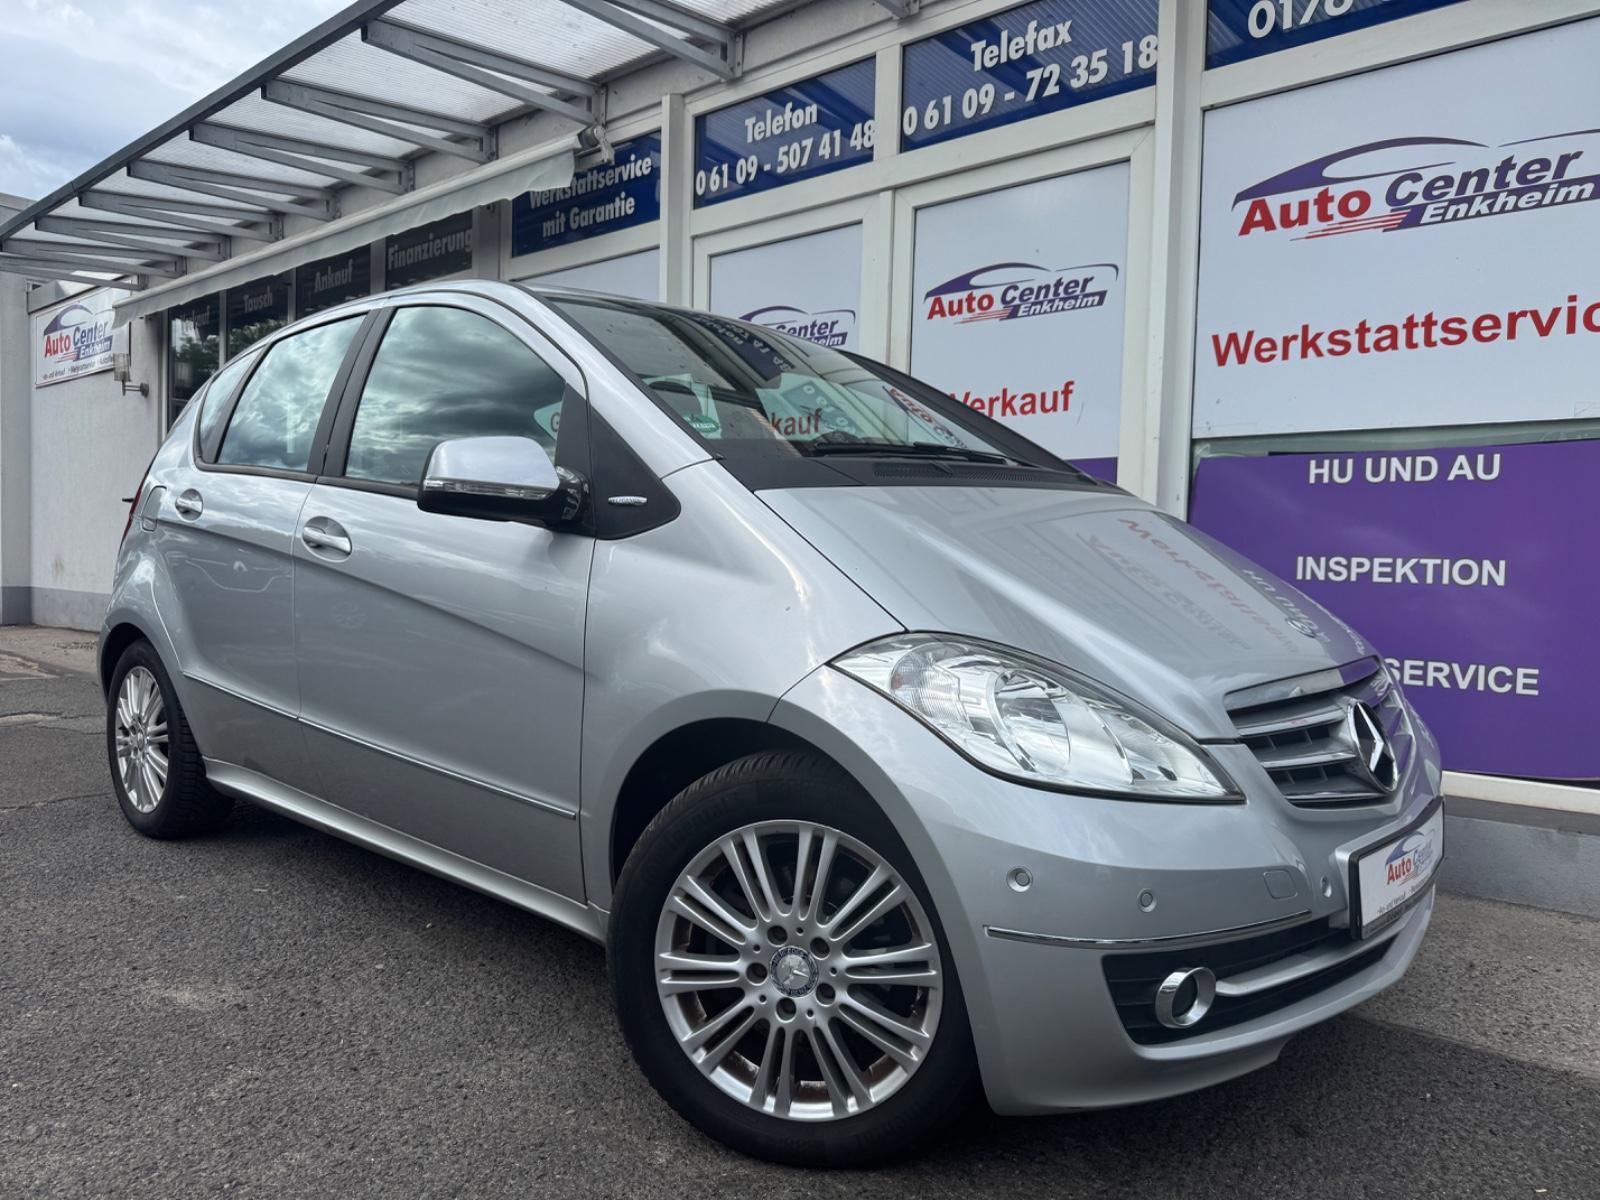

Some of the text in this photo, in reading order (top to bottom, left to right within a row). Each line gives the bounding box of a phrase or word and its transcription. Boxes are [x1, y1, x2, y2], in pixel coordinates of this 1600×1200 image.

[971, 20, 1073, 71] Telefax
[962, 83, 995, 119] 09
[1025, 63, 1061, 102] 72
[1070, 48, 1108, 89] 35
[1122, 34, 1158, 74] 18
[745, 102, 818, 143] Telefon
[736, 155, 758, 185] 09
[777, 137, 814, 173] 507
[818, 129, 841, 160] 41
[850, 120, 875, 150] 48
[542, 191, 635, 238] mit Garantie
[1238, 151, 1584, 237] Auto Center
[1420, 183, 1595, 225] Enkheim
[388, 228, 473, 271] Finanzierung
[315, 258, 353, 292] Ankauf
[927, 276, 1094, 320] Auto Center
[1017, 294, 1100, 317] Enkheim
[44, 321, 108, 358] Auto Center
[1309, 453, 1501, 484] HU UND AU
[1296, 556, 1506, 586] INSPEKTION
[1386, 857, 1412, 885] Auto
